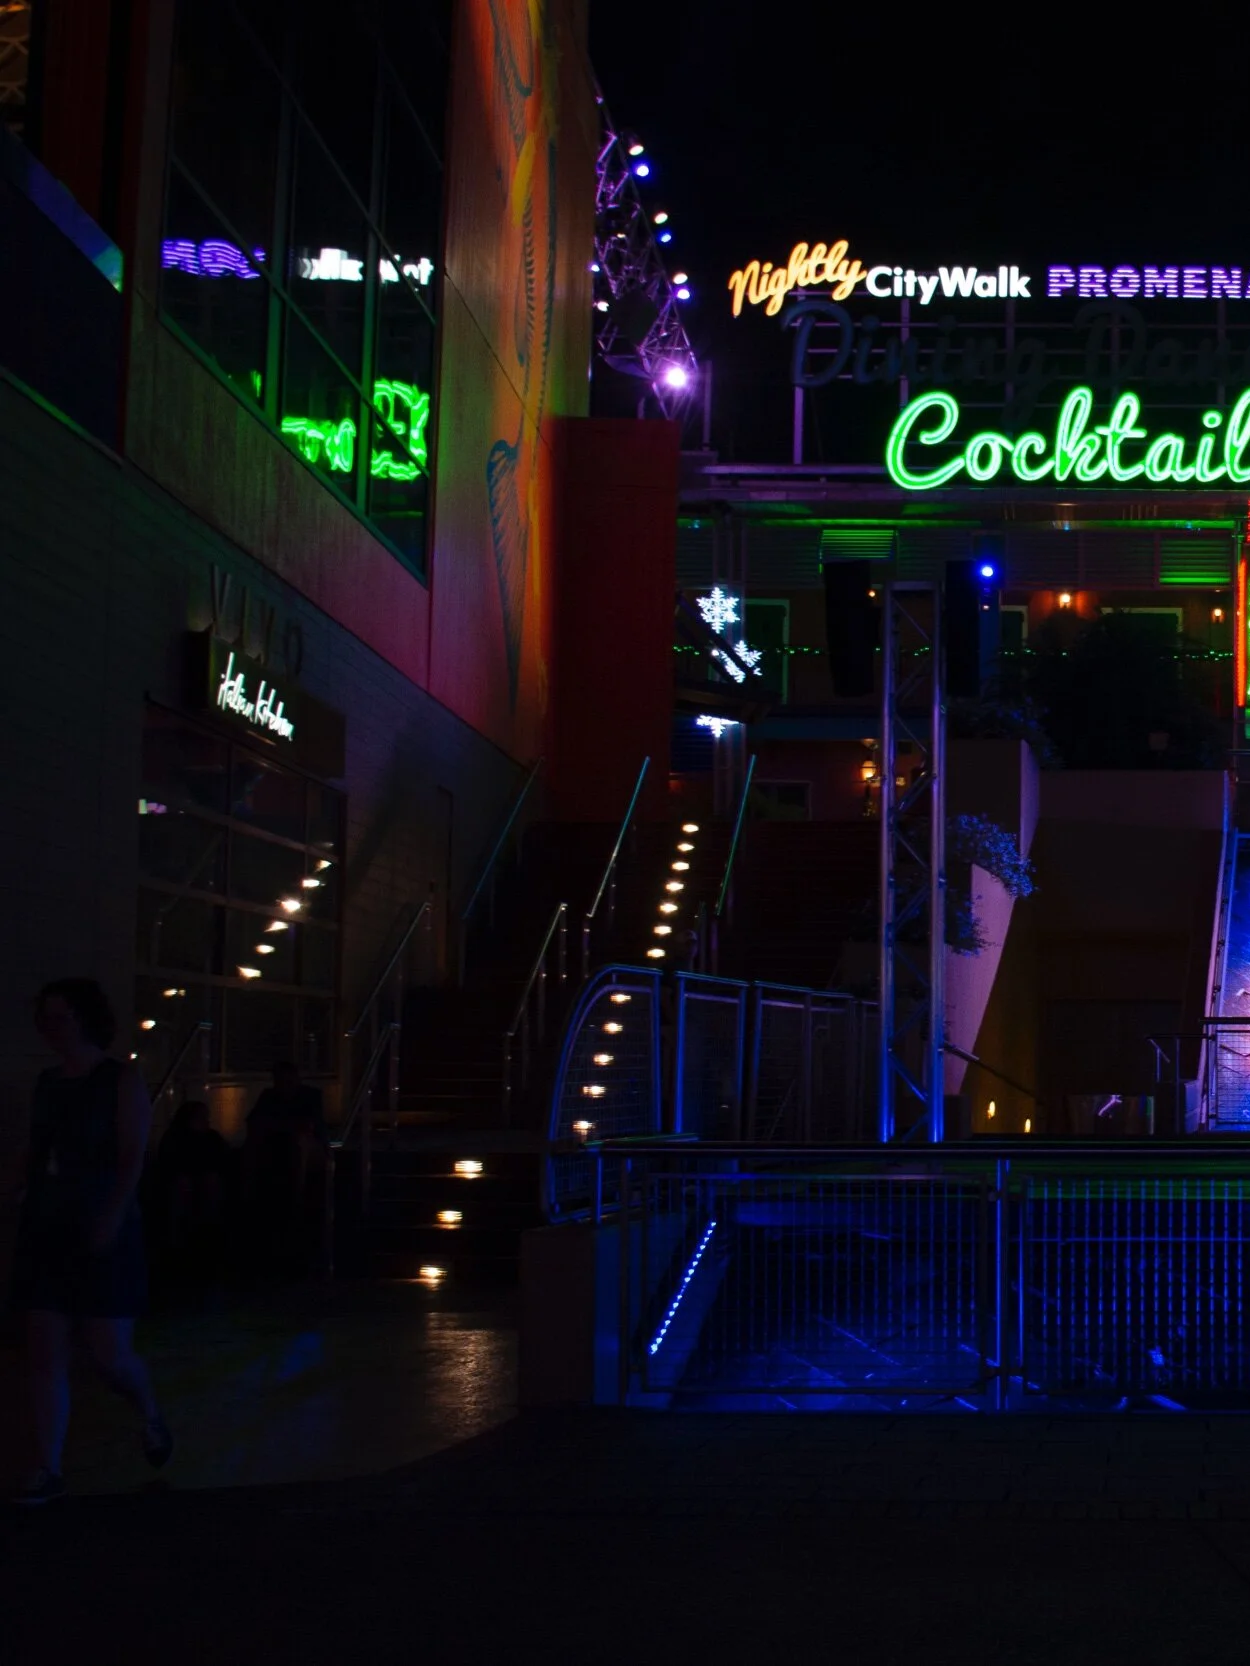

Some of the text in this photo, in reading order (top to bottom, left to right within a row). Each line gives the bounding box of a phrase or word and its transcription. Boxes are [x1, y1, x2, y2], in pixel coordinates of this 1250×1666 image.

[728, 239, 868, 319] Nightly
[864, 264, 1032, 306] CityWalk
[780, 299, 1058, 426] Dining
